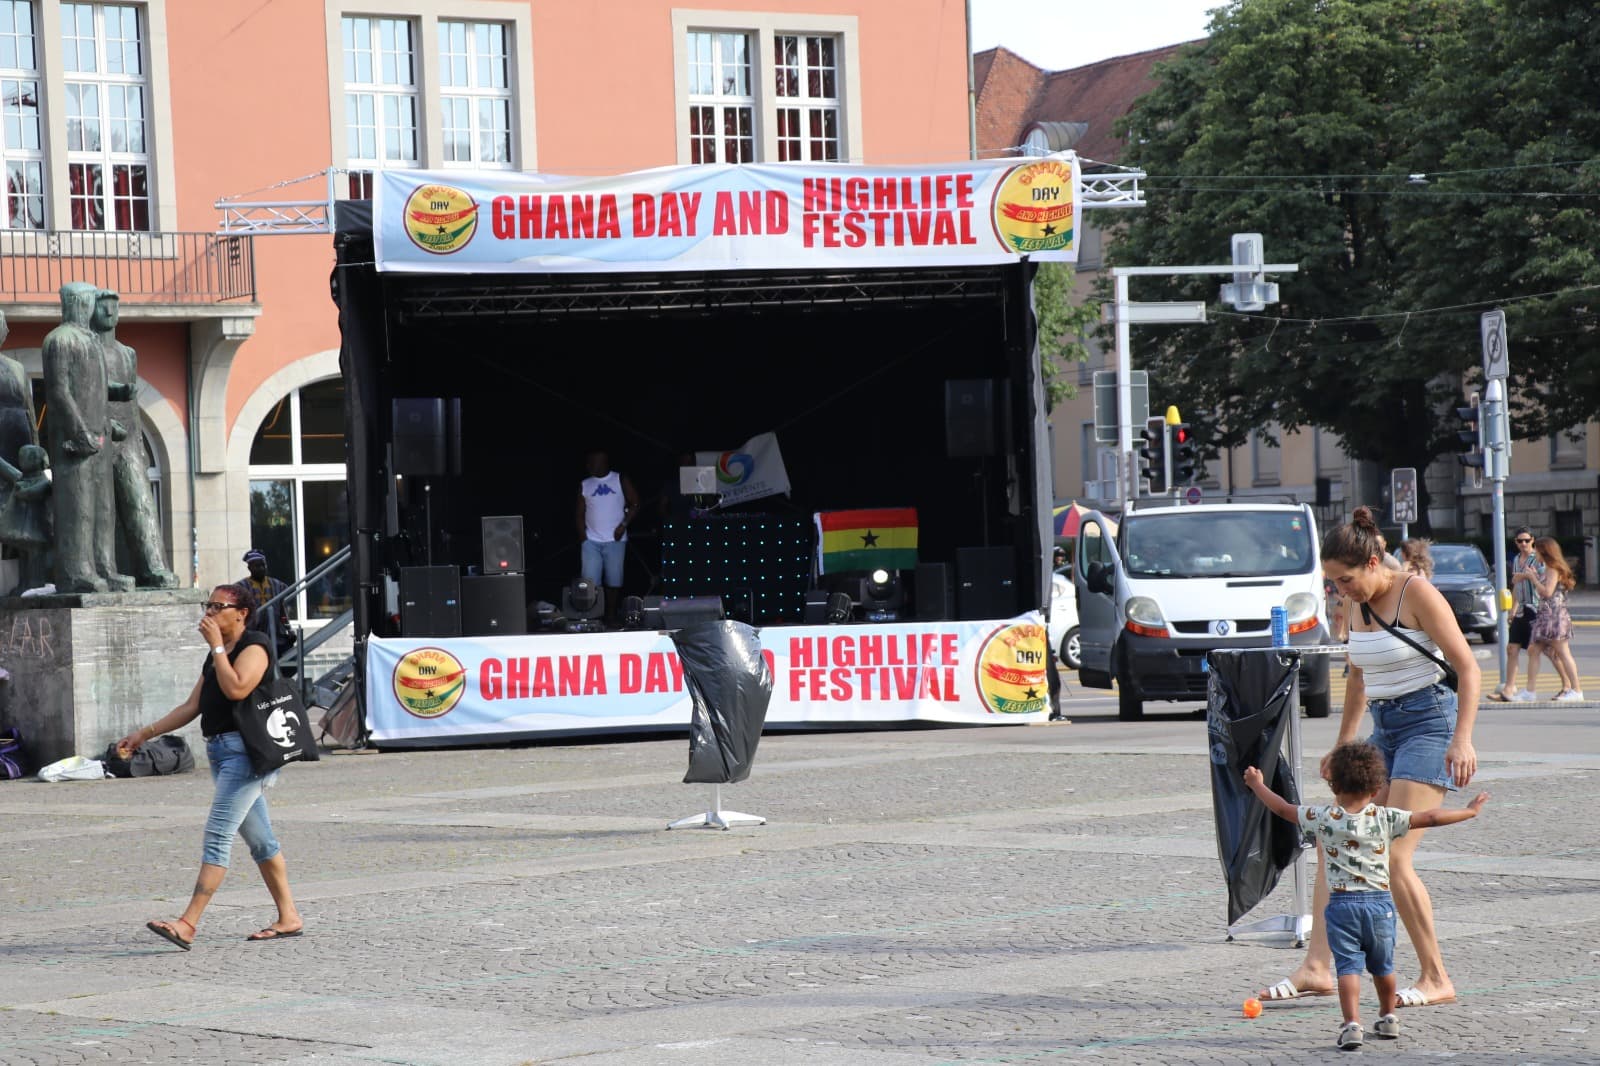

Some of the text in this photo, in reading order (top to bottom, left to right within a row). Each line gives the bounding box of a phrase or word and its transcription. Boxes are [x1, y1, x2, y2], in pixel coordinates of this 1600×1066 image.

[430, 201, 450, 210] DAY
[803, 175, 974, 212] HIGHLIFE
[1032, 187, 1060, 201] DAY
[492, 190, 789, 240] GHANA DAY AND
[803, 208, 977, 248] FESTIVAL
[1019, 235, 1065, 249] FESTIVAL
[789, 634, 960, 669] HIGHLIFE
[1016, 650, 1042, 664] DAY
[418, 666, 437, 675] DAY
[480, 652, 684, 701] GHANA DAY
[789, 667, 961, 702] FESTIVAL
